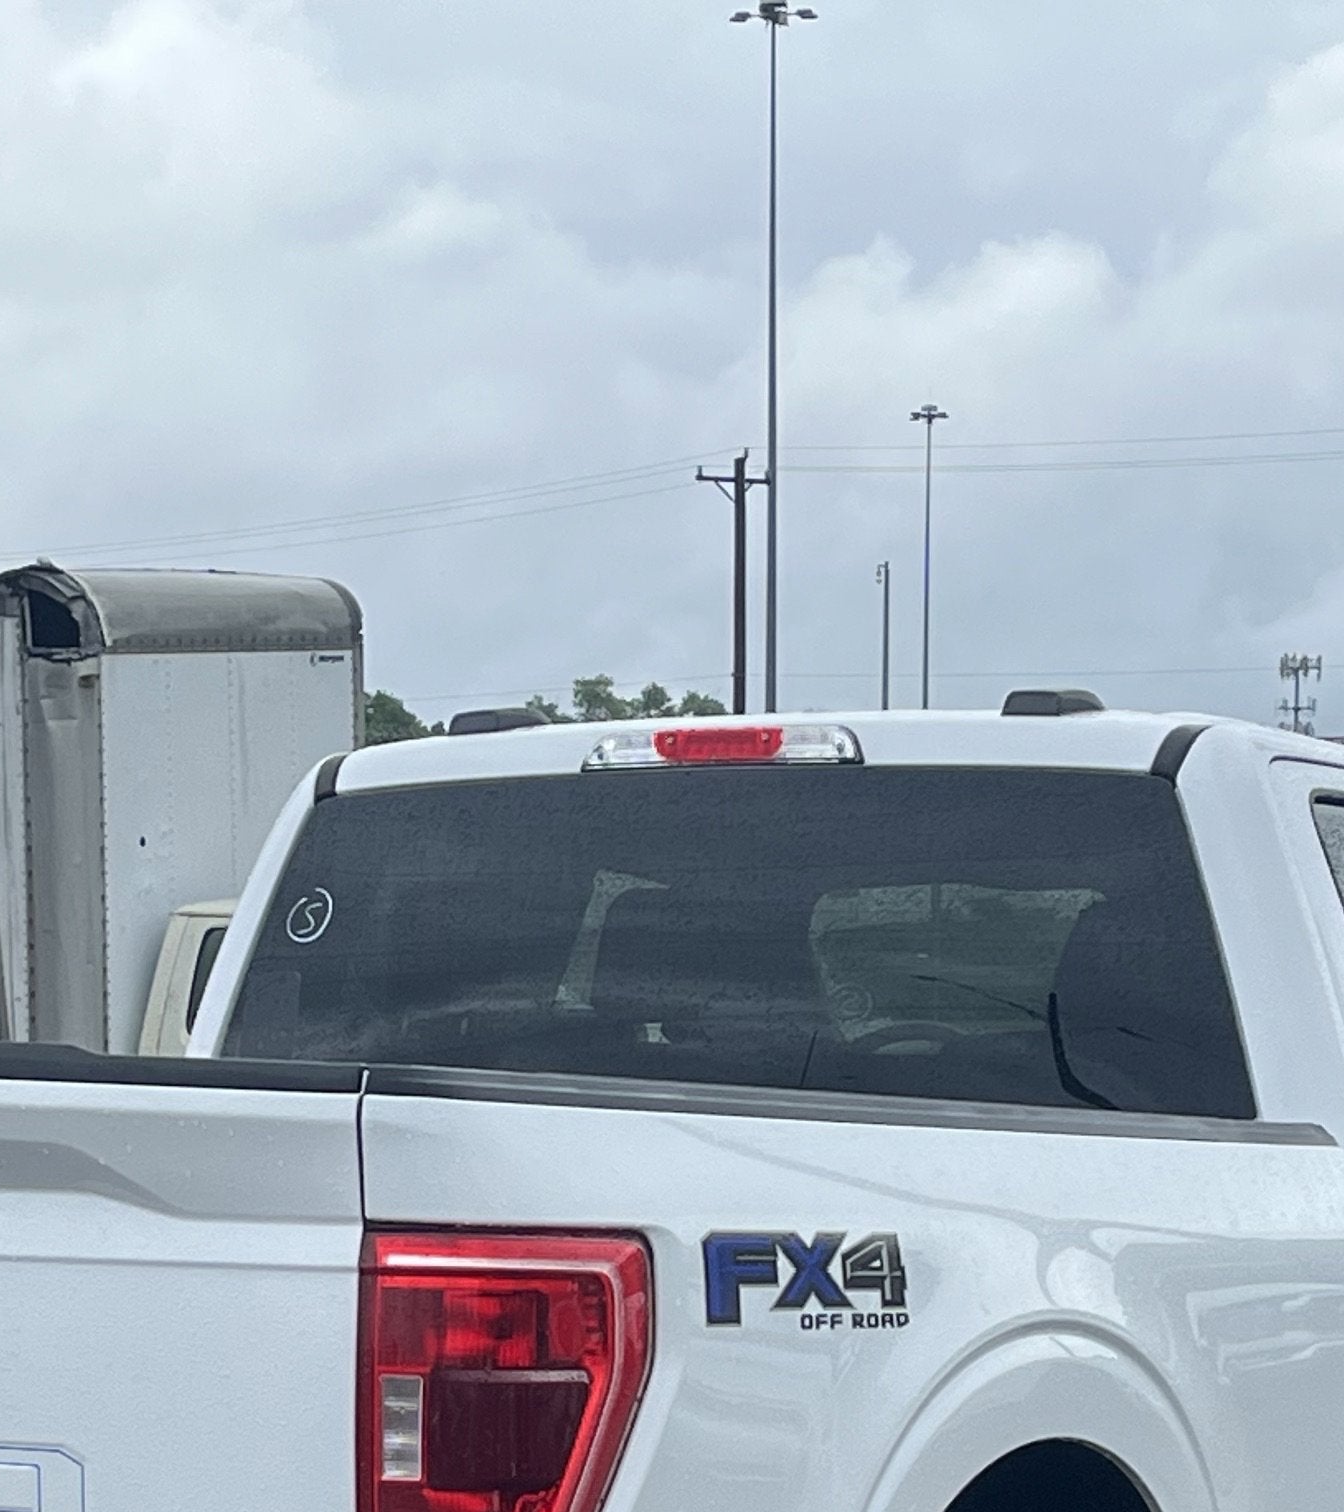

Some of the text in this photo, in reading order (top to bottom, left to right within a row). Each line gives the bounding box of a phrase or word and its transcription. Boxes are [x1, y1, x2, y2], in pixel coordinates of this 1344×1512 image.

[701, 1230, 907, 1327] FX4
[800, 1312, 910, 1330] OFF ROAD
